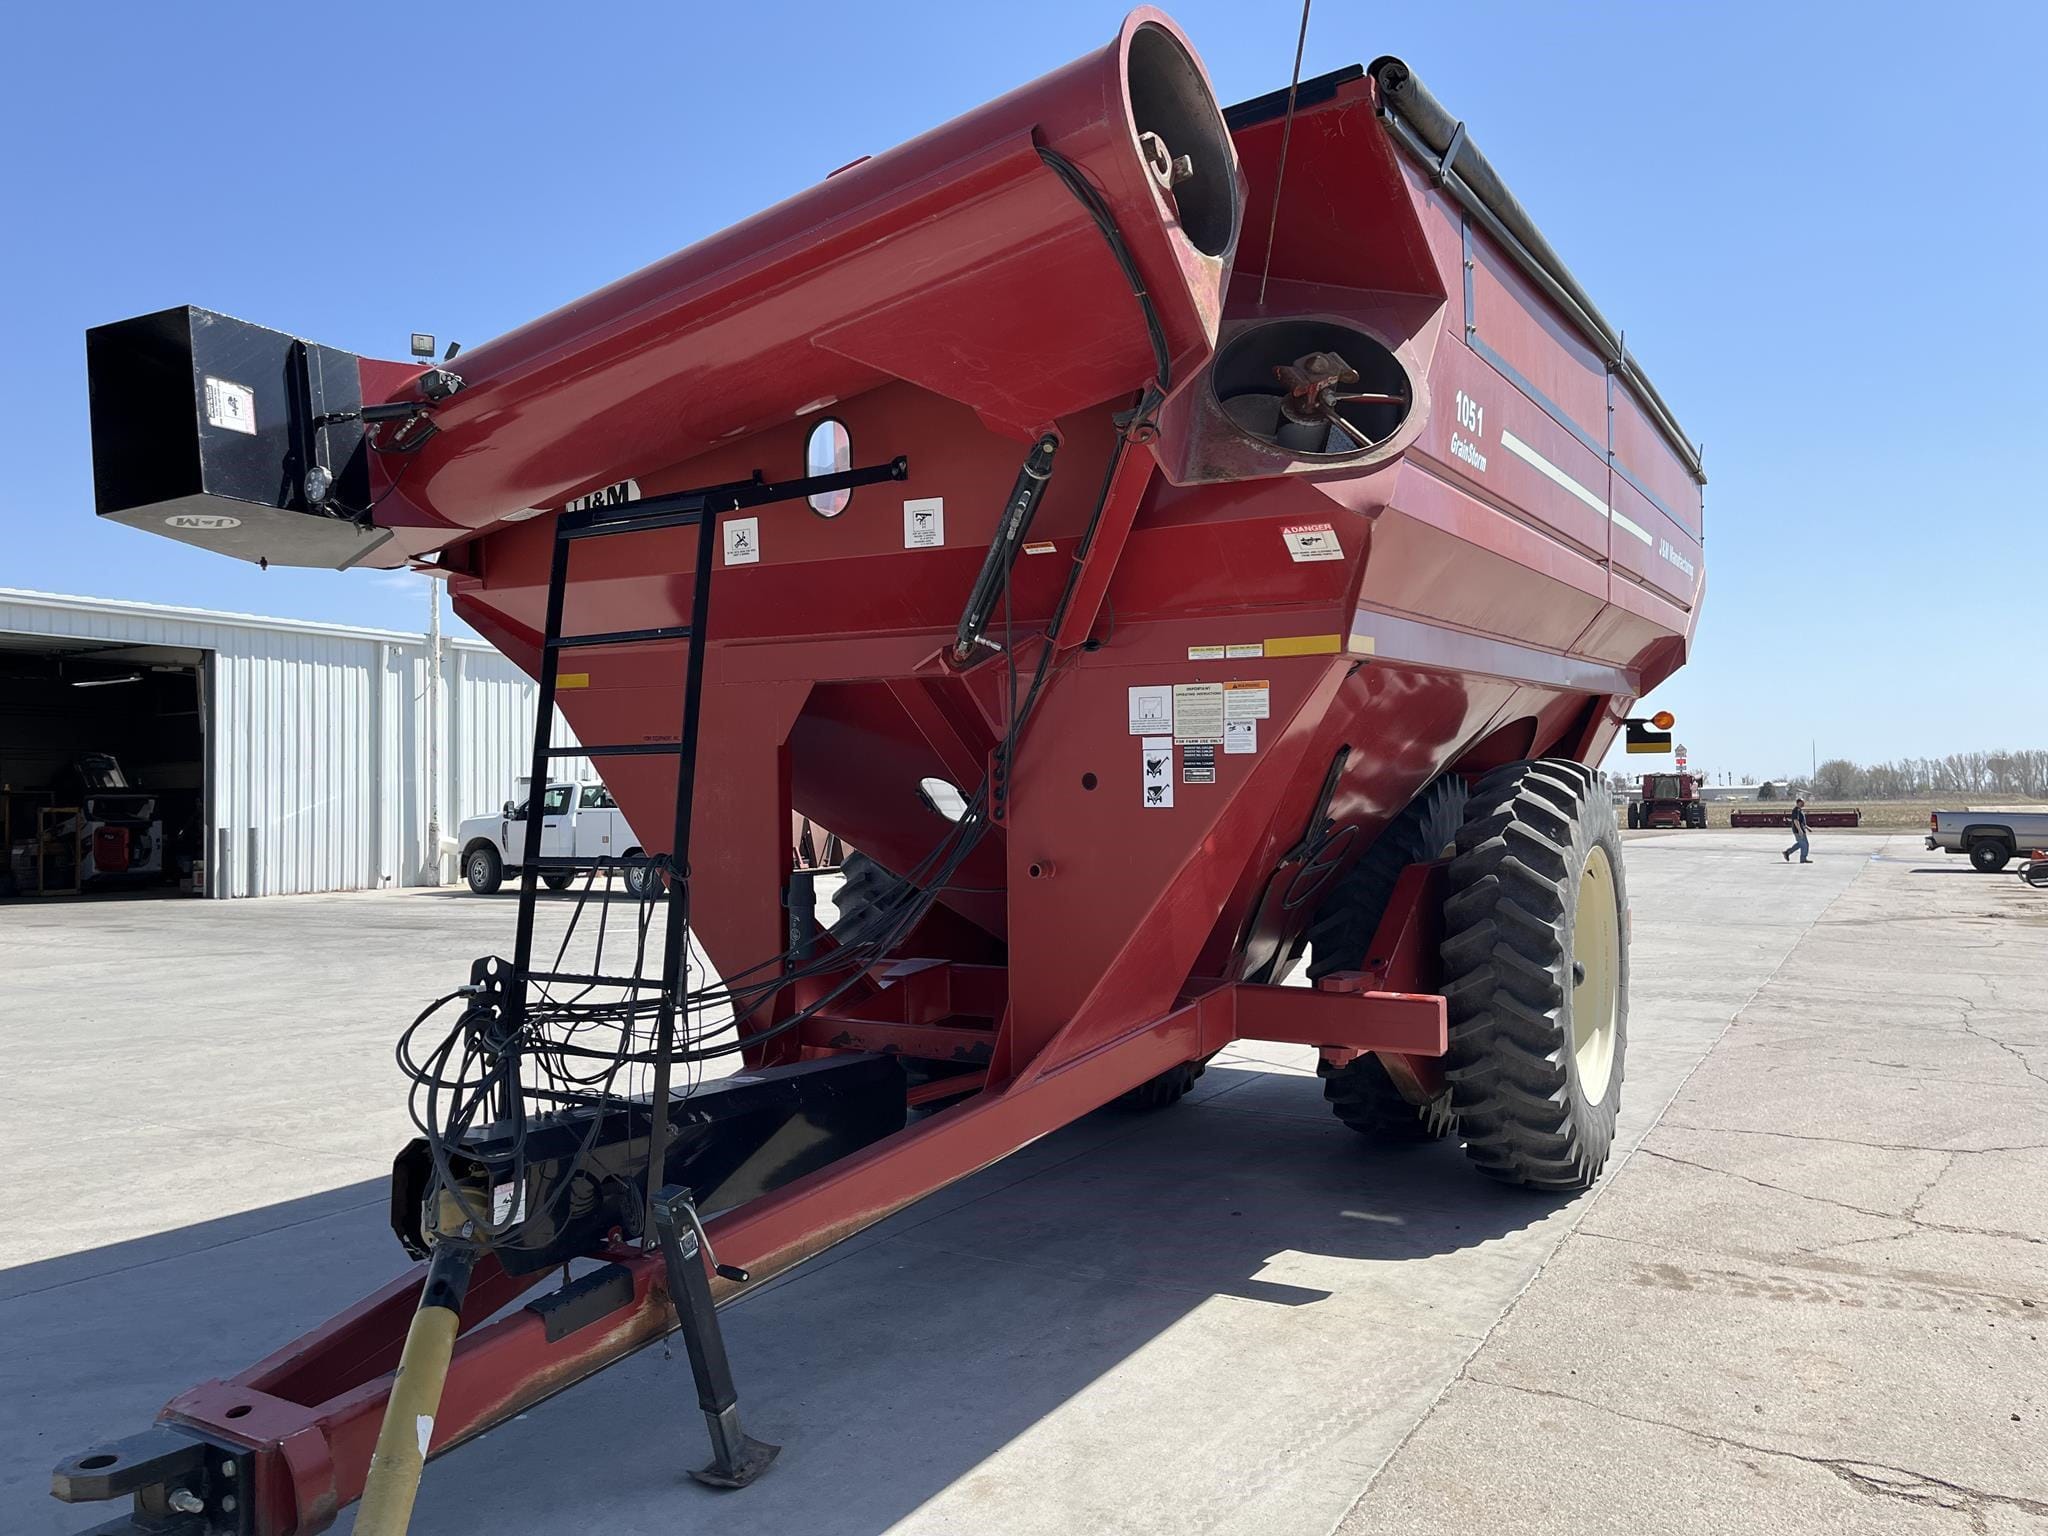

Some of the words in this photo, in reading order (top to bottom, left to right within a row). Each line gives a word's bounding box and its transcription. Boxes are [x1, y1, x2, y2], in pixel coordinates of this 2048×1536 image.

[1455, 389, 1484, 438] 1051
[1450, 431, 1488, 473] GrainStorm
[1290, 523, 1333, 533] DANGER
